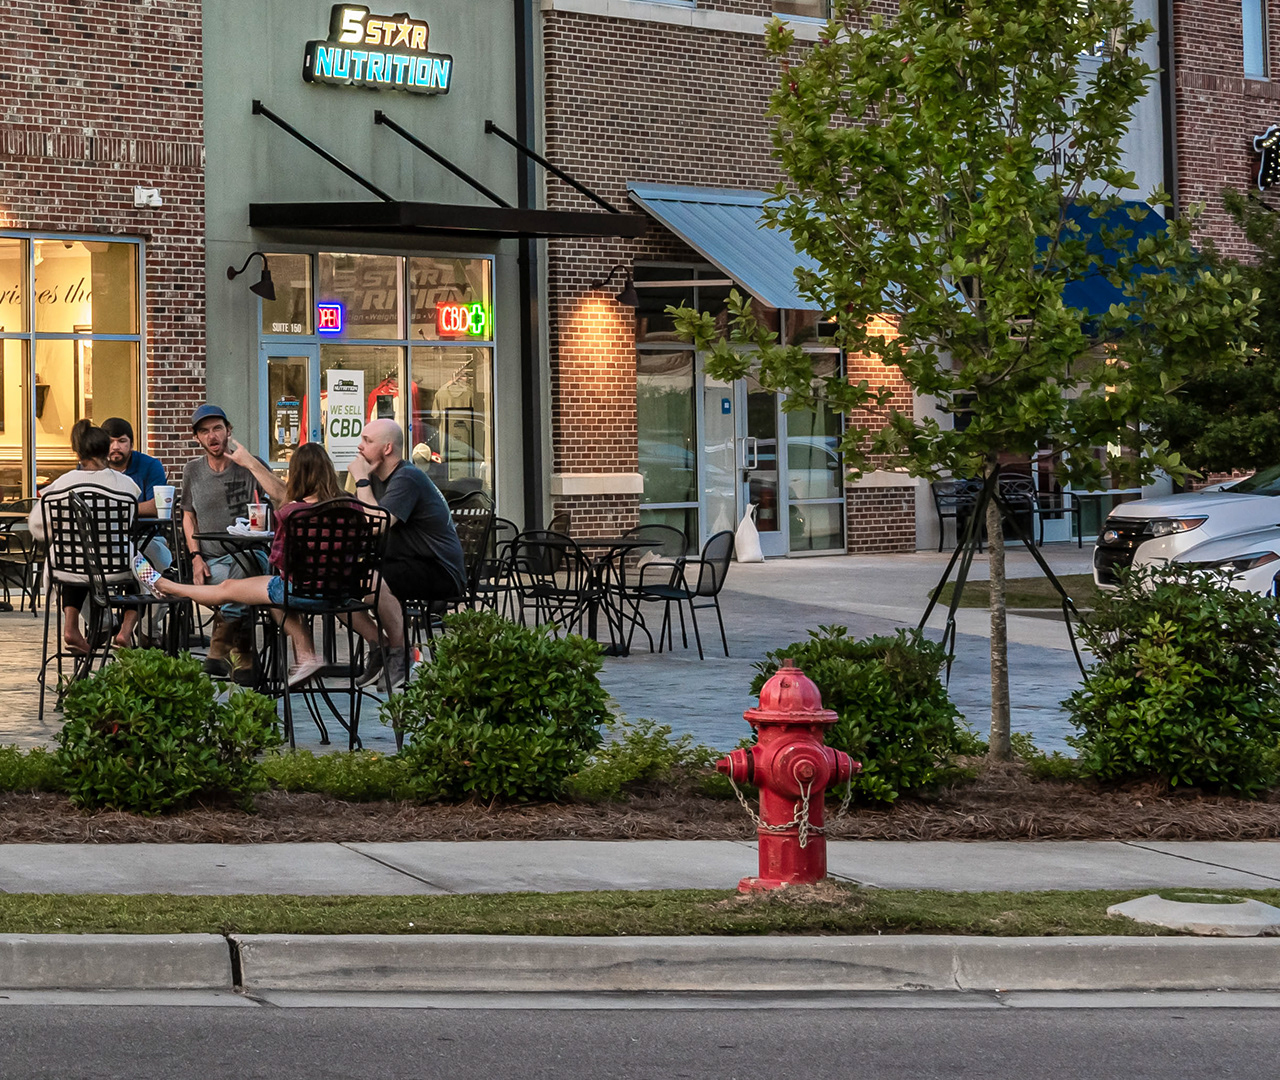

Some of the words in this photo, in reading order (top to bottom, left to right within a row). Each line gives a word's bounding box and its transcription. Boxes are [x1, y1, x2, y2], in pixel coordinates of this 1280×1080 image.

[339, 8, 367, 44] 5
[365, 18, 427, 49] STAR
[315, 47, 451, 89] NUTRITION
[272, 322, 289, 332] SUITE
[291, 323, 302, 333] 150
[441, 306, 469, 332] CBD
[330, 405, 340, 414] WE
[344, 405, 362, 415] SELL
[330, 418, 362, 437] CBD
